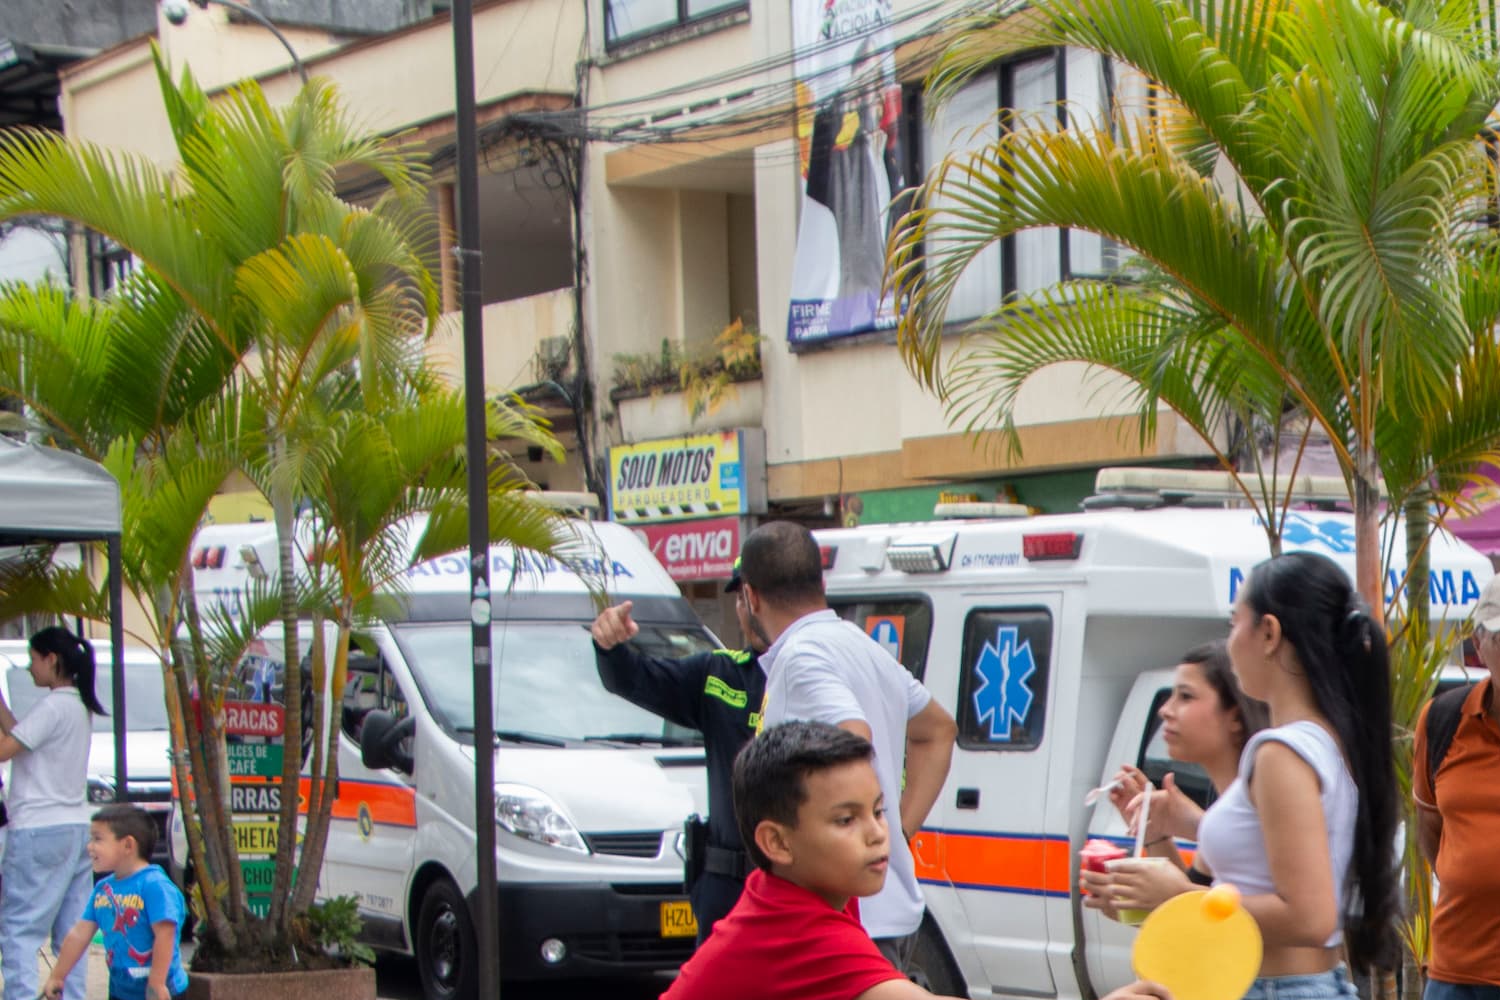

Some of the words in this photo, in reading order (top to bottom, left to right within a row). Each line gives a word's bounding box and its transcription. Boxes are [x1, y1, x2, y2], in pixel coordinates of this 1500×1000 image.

[618, 453, 657, 491] SOLO
[657, 446, 714, 487] MOTOS
[618, 487, 711, 507] PARQUEADERO
[221, 707, 278, 732] ARACAS
[255, 745, 268, 758] DE
[665, 908, 694, 928] HZU
